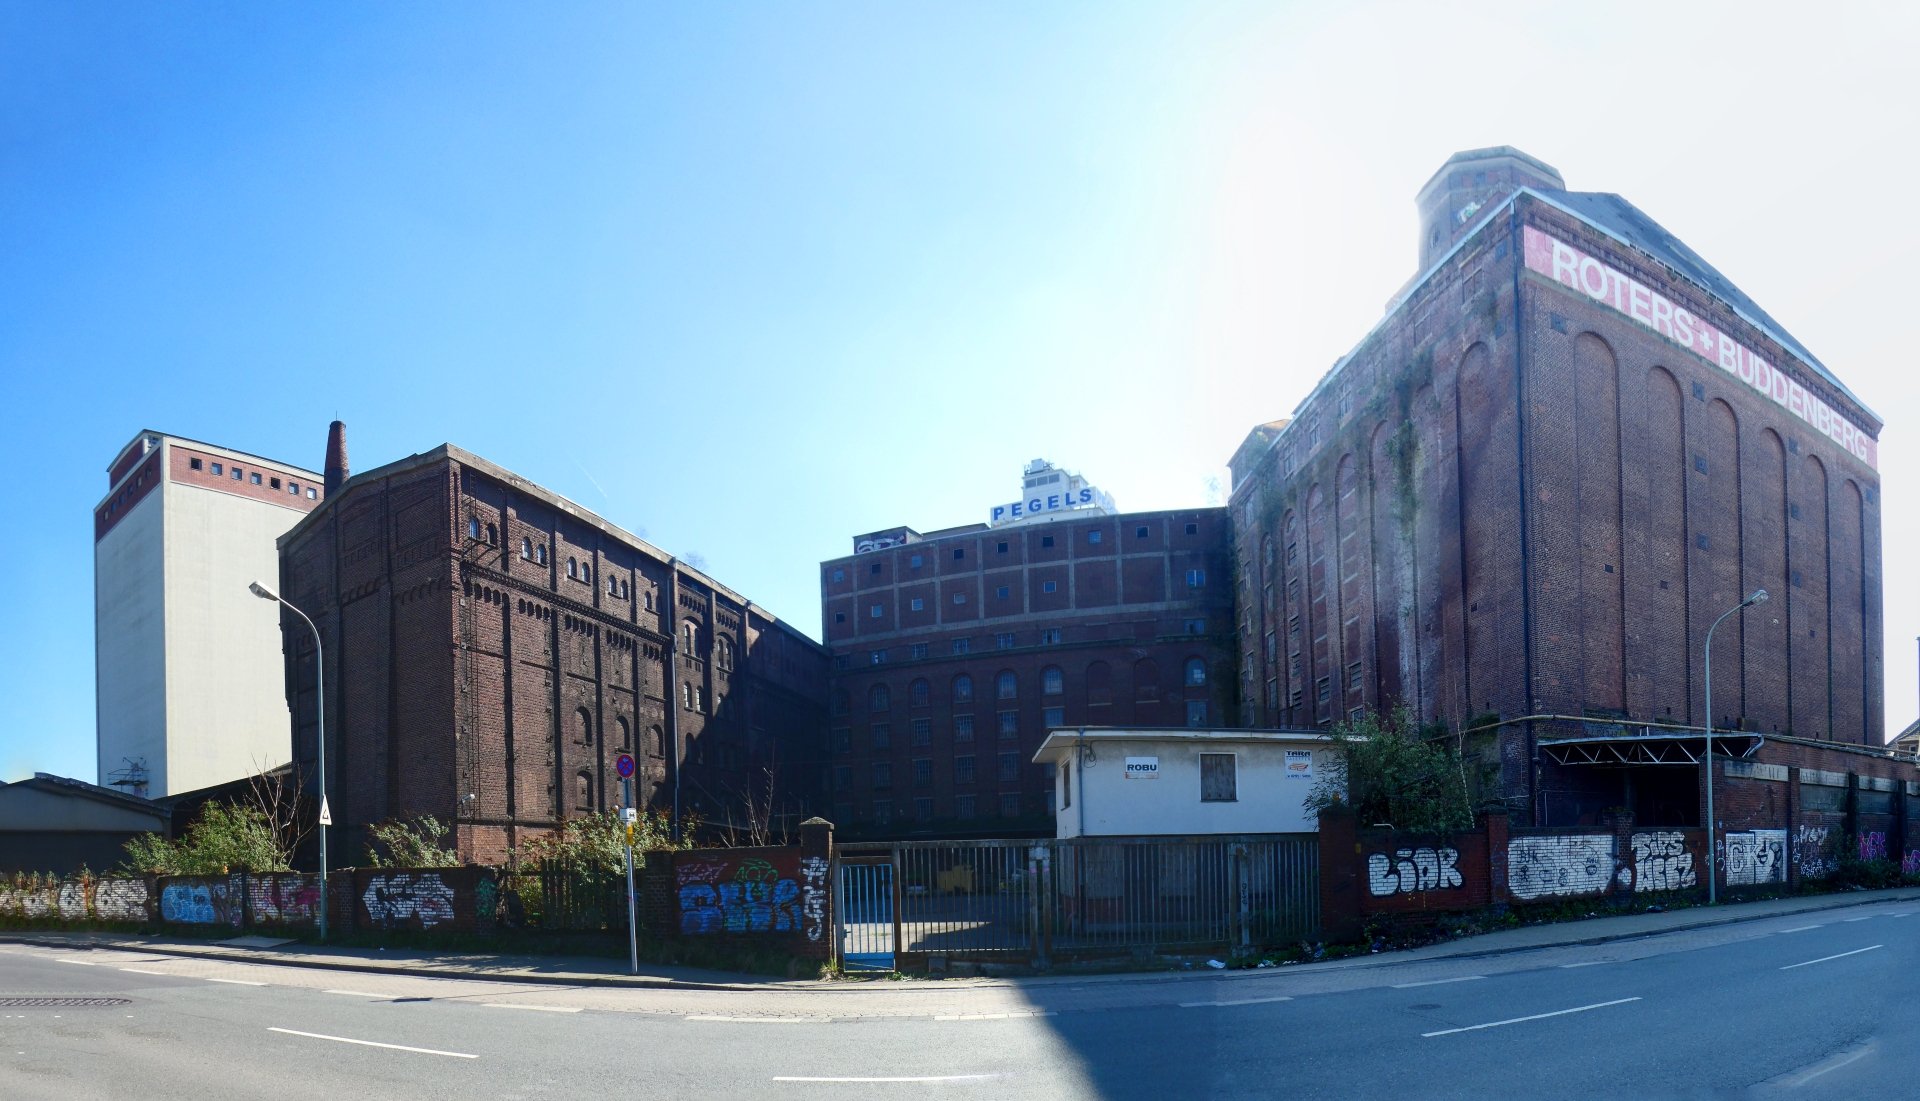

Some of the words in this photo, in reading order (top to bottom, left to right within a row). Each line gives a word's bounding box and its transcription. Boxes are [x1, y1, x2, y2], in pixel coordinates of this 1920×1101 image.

[1551, 238, 1695, 349] ROTERS
[1717, 331, 1868, 461] BUDDENBERG
[993, 488, 1093, 521] PEGELS
[1126, 763, 1157, 771] ROBU
